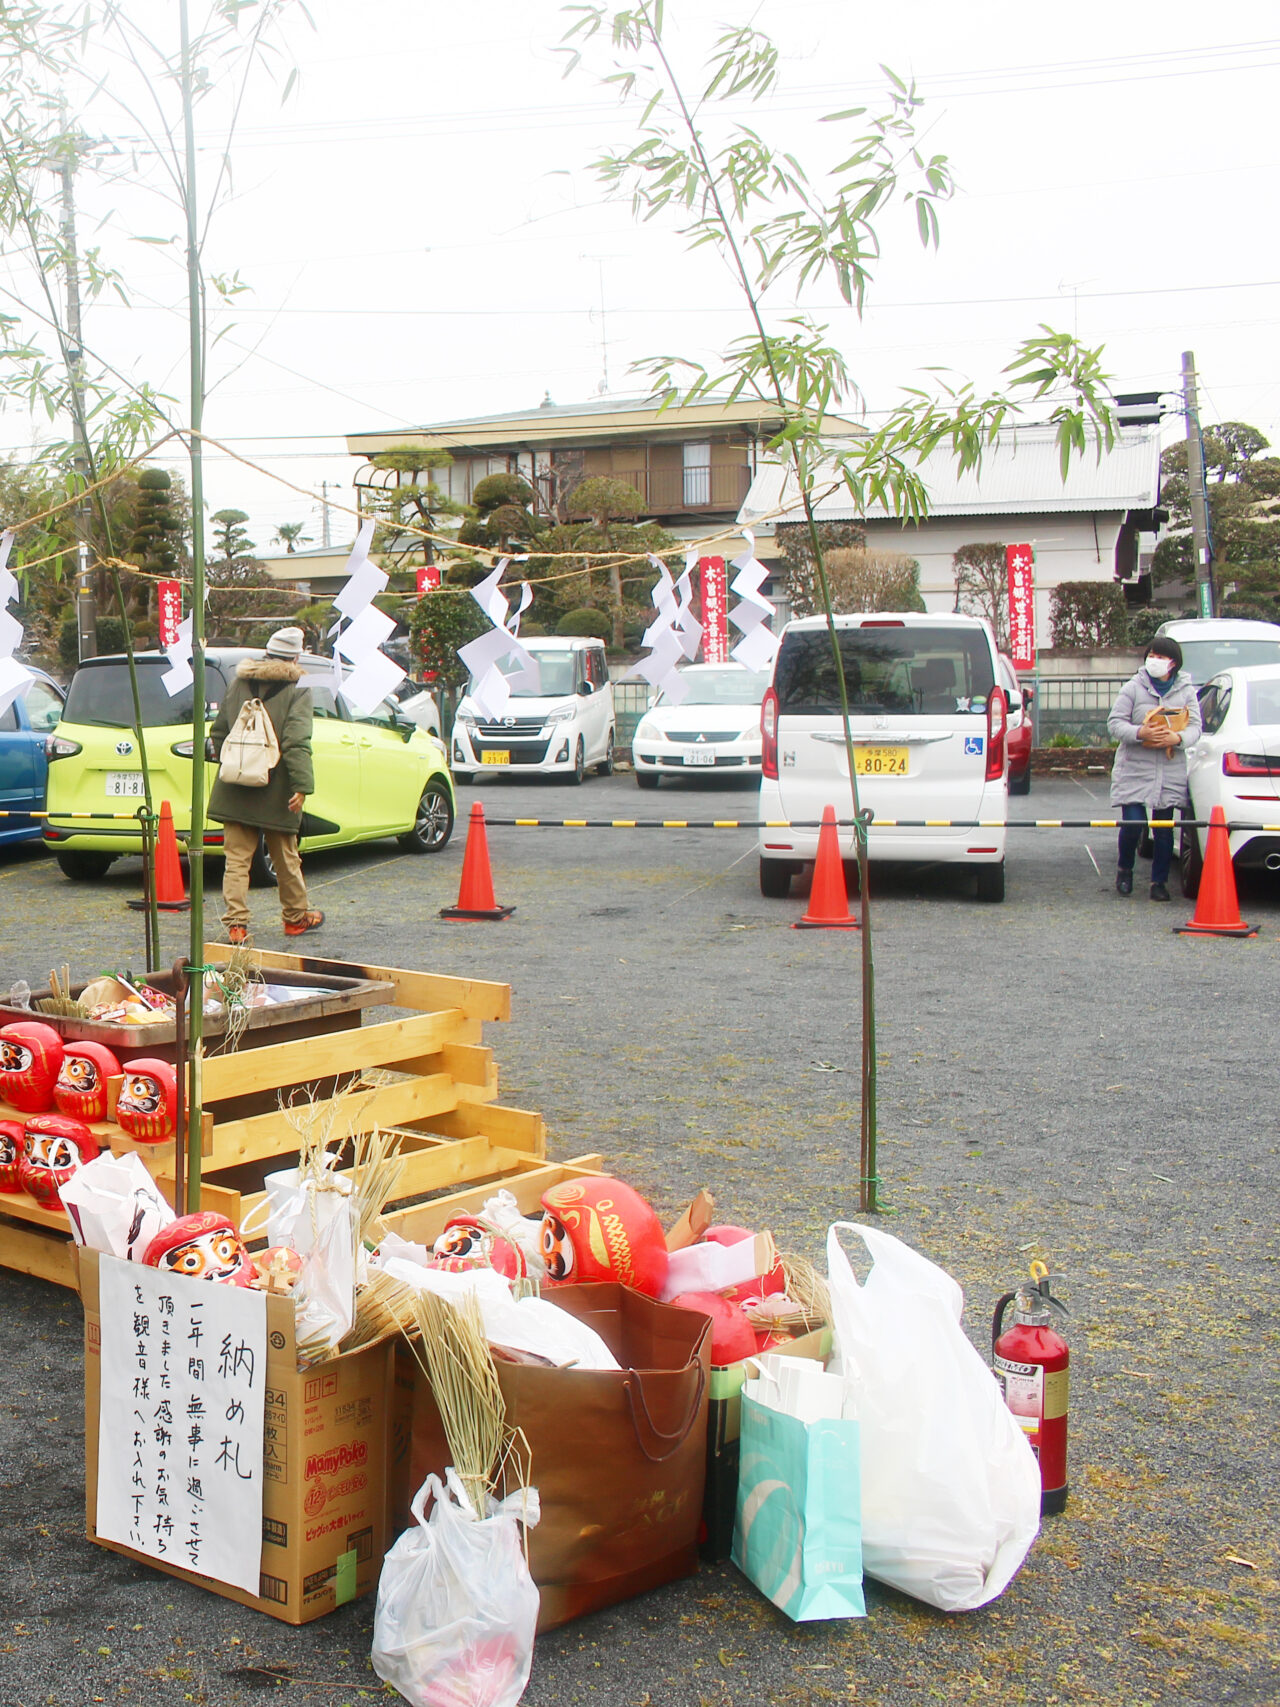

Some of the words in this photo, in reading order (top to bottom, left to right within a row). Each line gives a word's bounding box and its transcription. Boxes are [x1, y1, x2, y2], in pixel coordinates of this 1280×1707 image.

[865, 758, 906, 772] 80-24
[115, 781, 144, 795] 81-81
[214, 1333, 255, 1480] 納め札
[306, 1442, 367, 1479] MamyPoko
